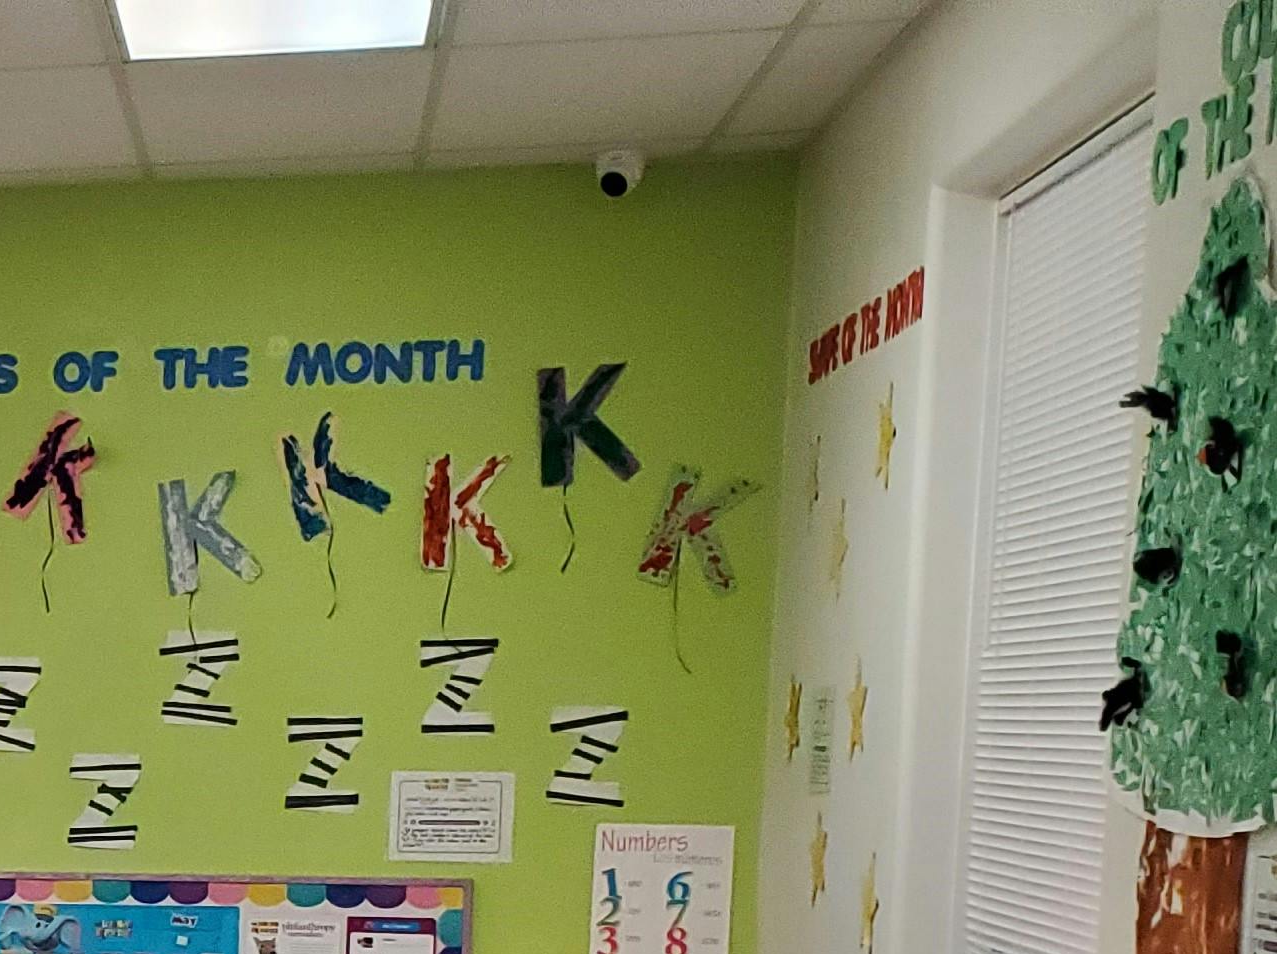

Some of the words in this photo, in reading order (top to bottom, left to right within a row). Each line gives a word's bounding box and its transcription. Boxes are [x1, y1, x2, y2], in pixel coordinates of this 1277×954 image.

[1152, 118, 1189, 206] OF
[1201, 74, 1255, 181] THE
[52, 351, 119, 393] OF
[154, 345, 249, 390] THE
[285, 340, 485, 386] MONTH
[536, 362, 641, 487] K
[2, 410, 96, 545] K
[277, 411, 392, 542] K
[420, 453, 512, 573] K
[159, 470, 262, 597] K
[637, 463, 763, 591] K
[601, 830, 689, 852] Numbers
[601, 868, 623, 900] 1
[596, 897, 621, 926] 2
[666, 900, 689, 928] 7
[667, 871, 693, 903] 6
[597, 926, 618, 954] 3
